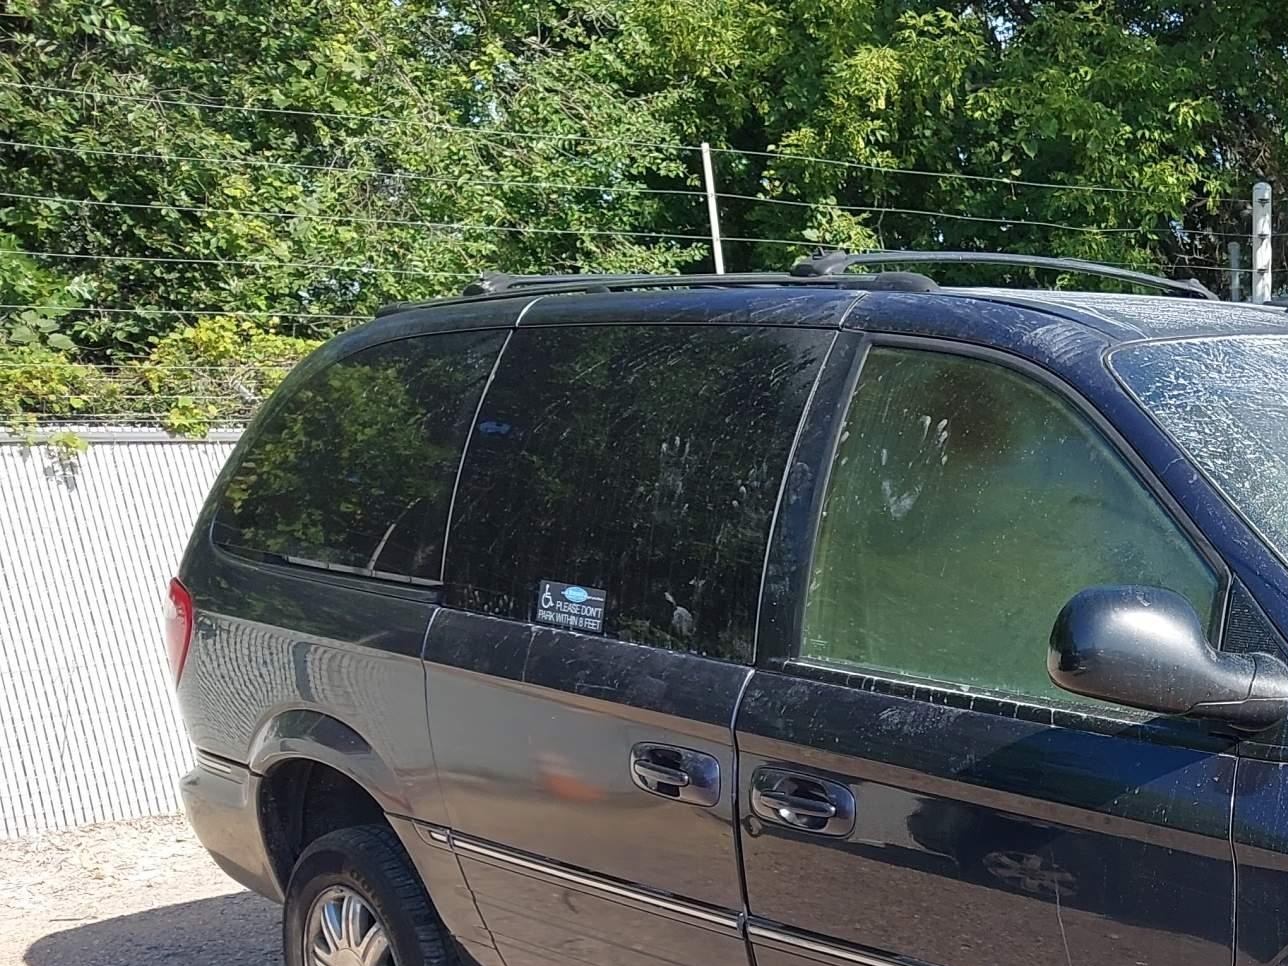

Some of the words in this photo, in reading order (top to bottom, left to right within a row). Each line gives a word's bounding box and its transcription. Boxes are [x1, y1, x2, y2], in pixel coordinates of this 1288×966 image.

[556, 601, 581, 614] PLEASE
[538, 609, 555, 621] PARK
[555, 612, 578, 625] WITHIN
[578, 617, 584, 627] 8
[584, 618, 601, 630] FEET
